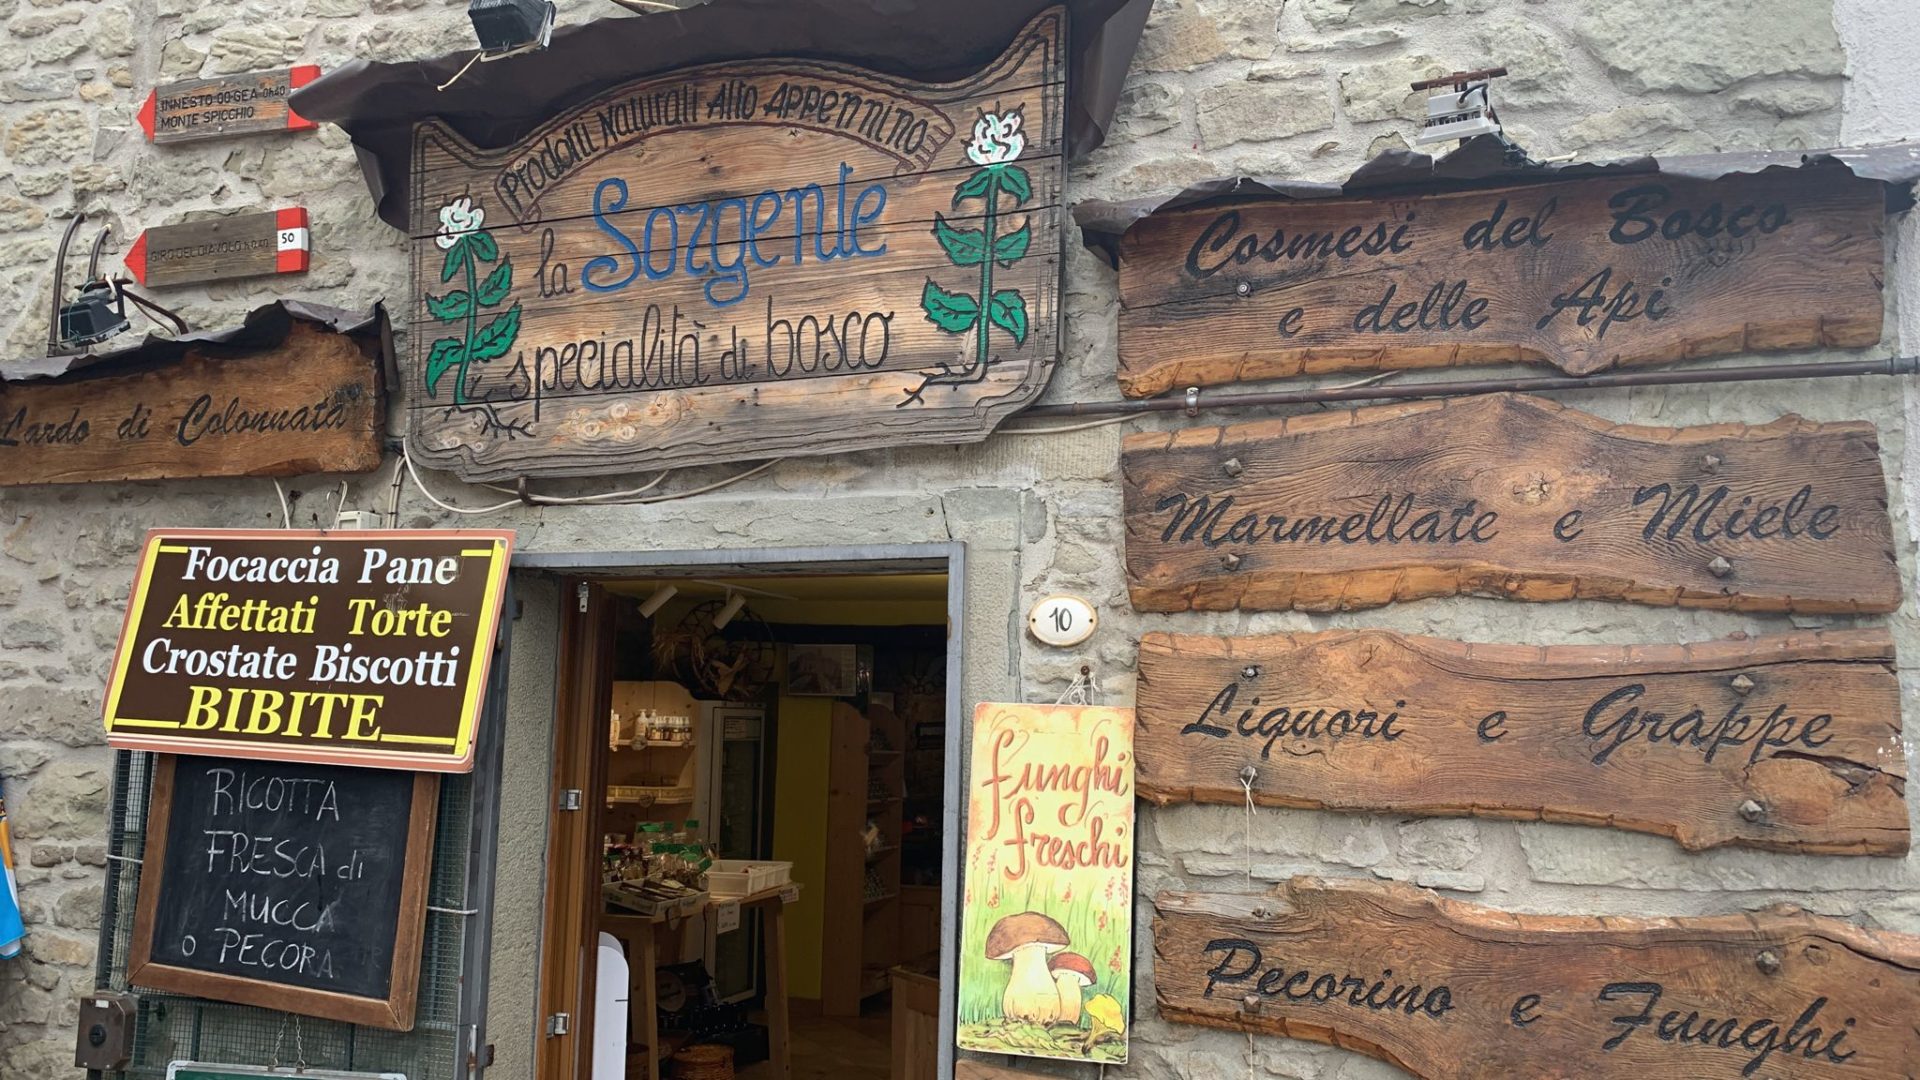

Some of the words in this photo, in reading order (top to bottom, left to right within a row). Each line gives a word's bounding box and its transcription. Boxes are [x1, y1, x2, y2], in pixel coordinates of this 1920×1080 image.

[160, 93, 213, 112] INNESTO
[160, 113, 200, 129] MONTE
[203, 106, 255, 123] SPICCHIO
[500, 116, 600, 206] Prodotti
[596, 84, 698, 149] Naturali
[707, 79, 758, 120] Alto
[281, 232, 295, 244] 50
[533, 228, 575, 298] la
[581, 162, 888, 308] Sorgente
[1186, 210, 1417, 279] Cosmesi
[1462, 200, 1558, 252] del
[1608, 185, 1795, 245] Bosco
[1278, 306, 1305, 339] e
[1354, 279, 1491, 336] delle
[1535, 266, 1675, 341] Api
[505, 304, 710, 422] specialità
[720, 327, 754, 381] di
[766, 296, 895, 378] bosco
[0, 406, 91, 447] Lardo
[118, 403, 152, 440] di
[177, 393, 347, 447] Colonnata
[1154, 491, 1501, 546] Marmellate
[1553, 508, 1584, 543] e
[1631, 481, 1843, 546] Miele
[181, 545, 340, 584] Focaccia
[356, 547, 457, 586] Pane
[162, 592, 319, 635] Affettati
[347, 598, 452, 638] Torte
[1048, 607, 1073, 633] 10
[142, 638, 297, 680] Crostate
[309, 643, 460, 687] Biscotti
[179, 685, 385, 742] BIBITE
[1181, 681, 1407, 760] Liquori
[1476, 709, 1509, 743] e
[1581, 683, 1835, 765] Grappe
[206, 768, 340, 821] RICOTTA
[982, 728, 1129, 840] funghi
[203, 830, 326, 878] FRESCA
[337, 850, 363, 881] di
[1003, 798, 1129, 881] freschi
[223, 888, 336, 933] MUCCA
[214, 927, 335, 979] PECORA
[1200, 939, 1456, 1022] Pecorino
[1510, 992, 1544, 1029] e
[1599, 981, 1859, 1077] Funghi
